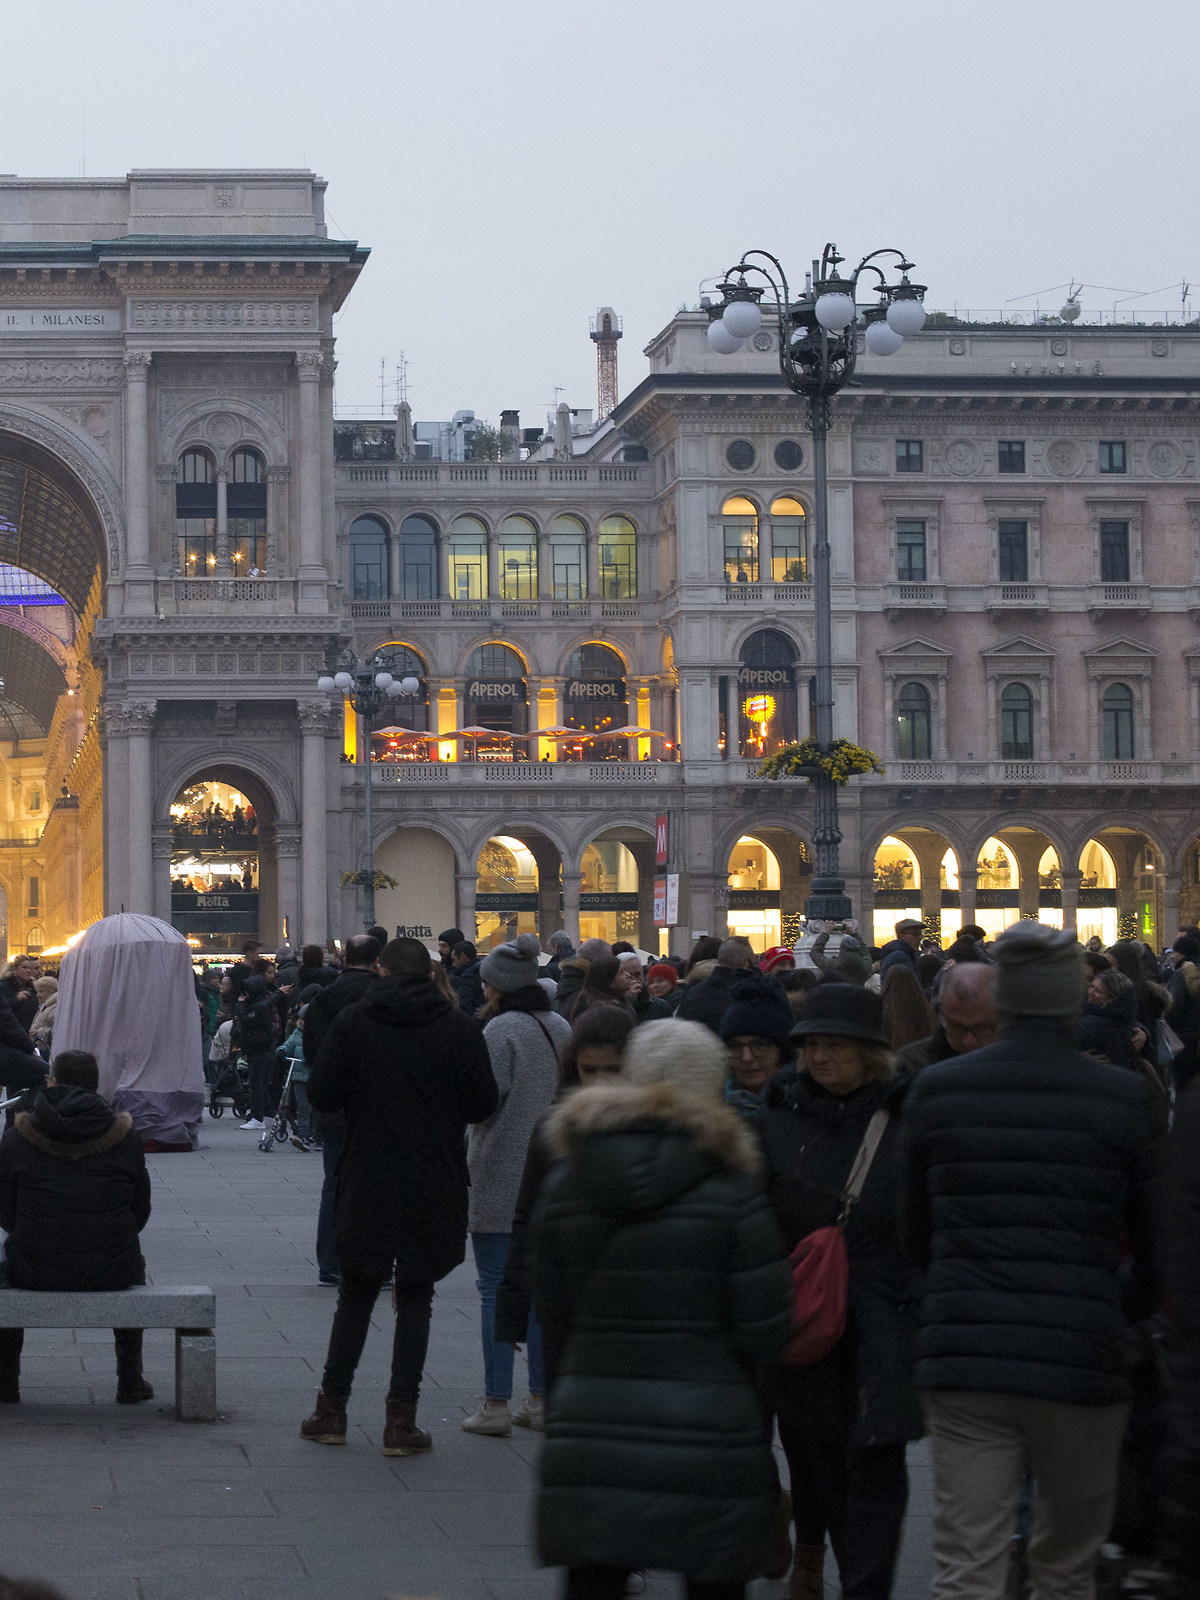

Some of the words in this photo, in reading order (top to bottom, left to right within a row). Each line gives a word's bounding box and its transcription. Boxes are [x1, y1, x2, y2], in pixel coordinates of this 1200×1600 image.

[42, 314, 105, 326] MILANESI
[739, 667, 790, 683] APEROL
[469, 681, 519, 697] APEROL
[568, 681, 619, 697] APEROL
[656, 824, 667, 854] M
[196, 896, 230, 907] Motta
[395, 925, 433, 939] Motta
